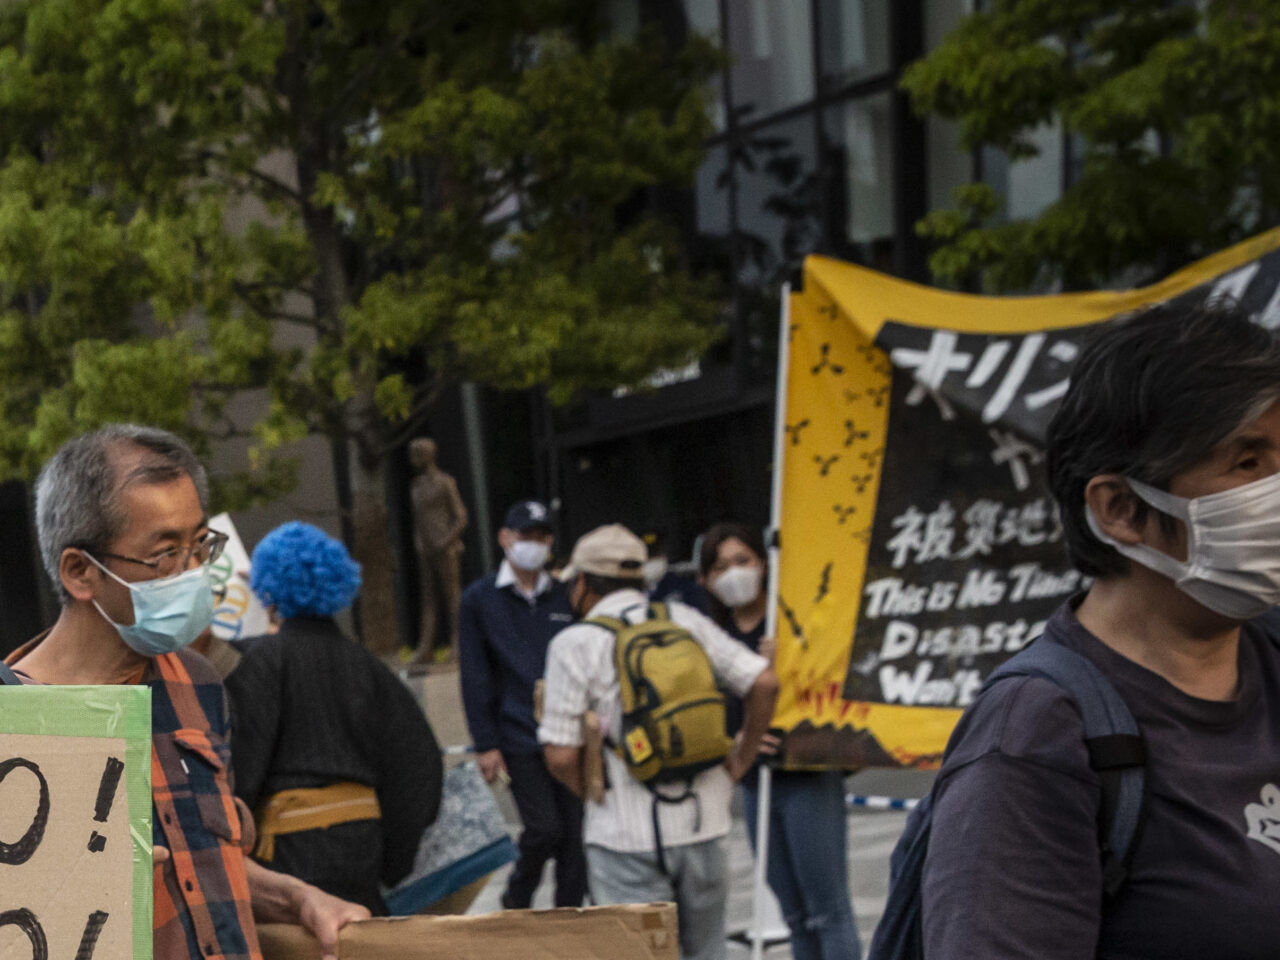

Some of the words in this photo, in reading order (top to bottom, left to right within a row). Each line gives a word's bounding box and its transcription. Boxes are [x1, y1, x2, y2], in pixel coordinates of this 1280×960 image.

[865, 577, 926, 618] This
[926, 580, 958, 611] is
[956, 569, 1007, 609] No
